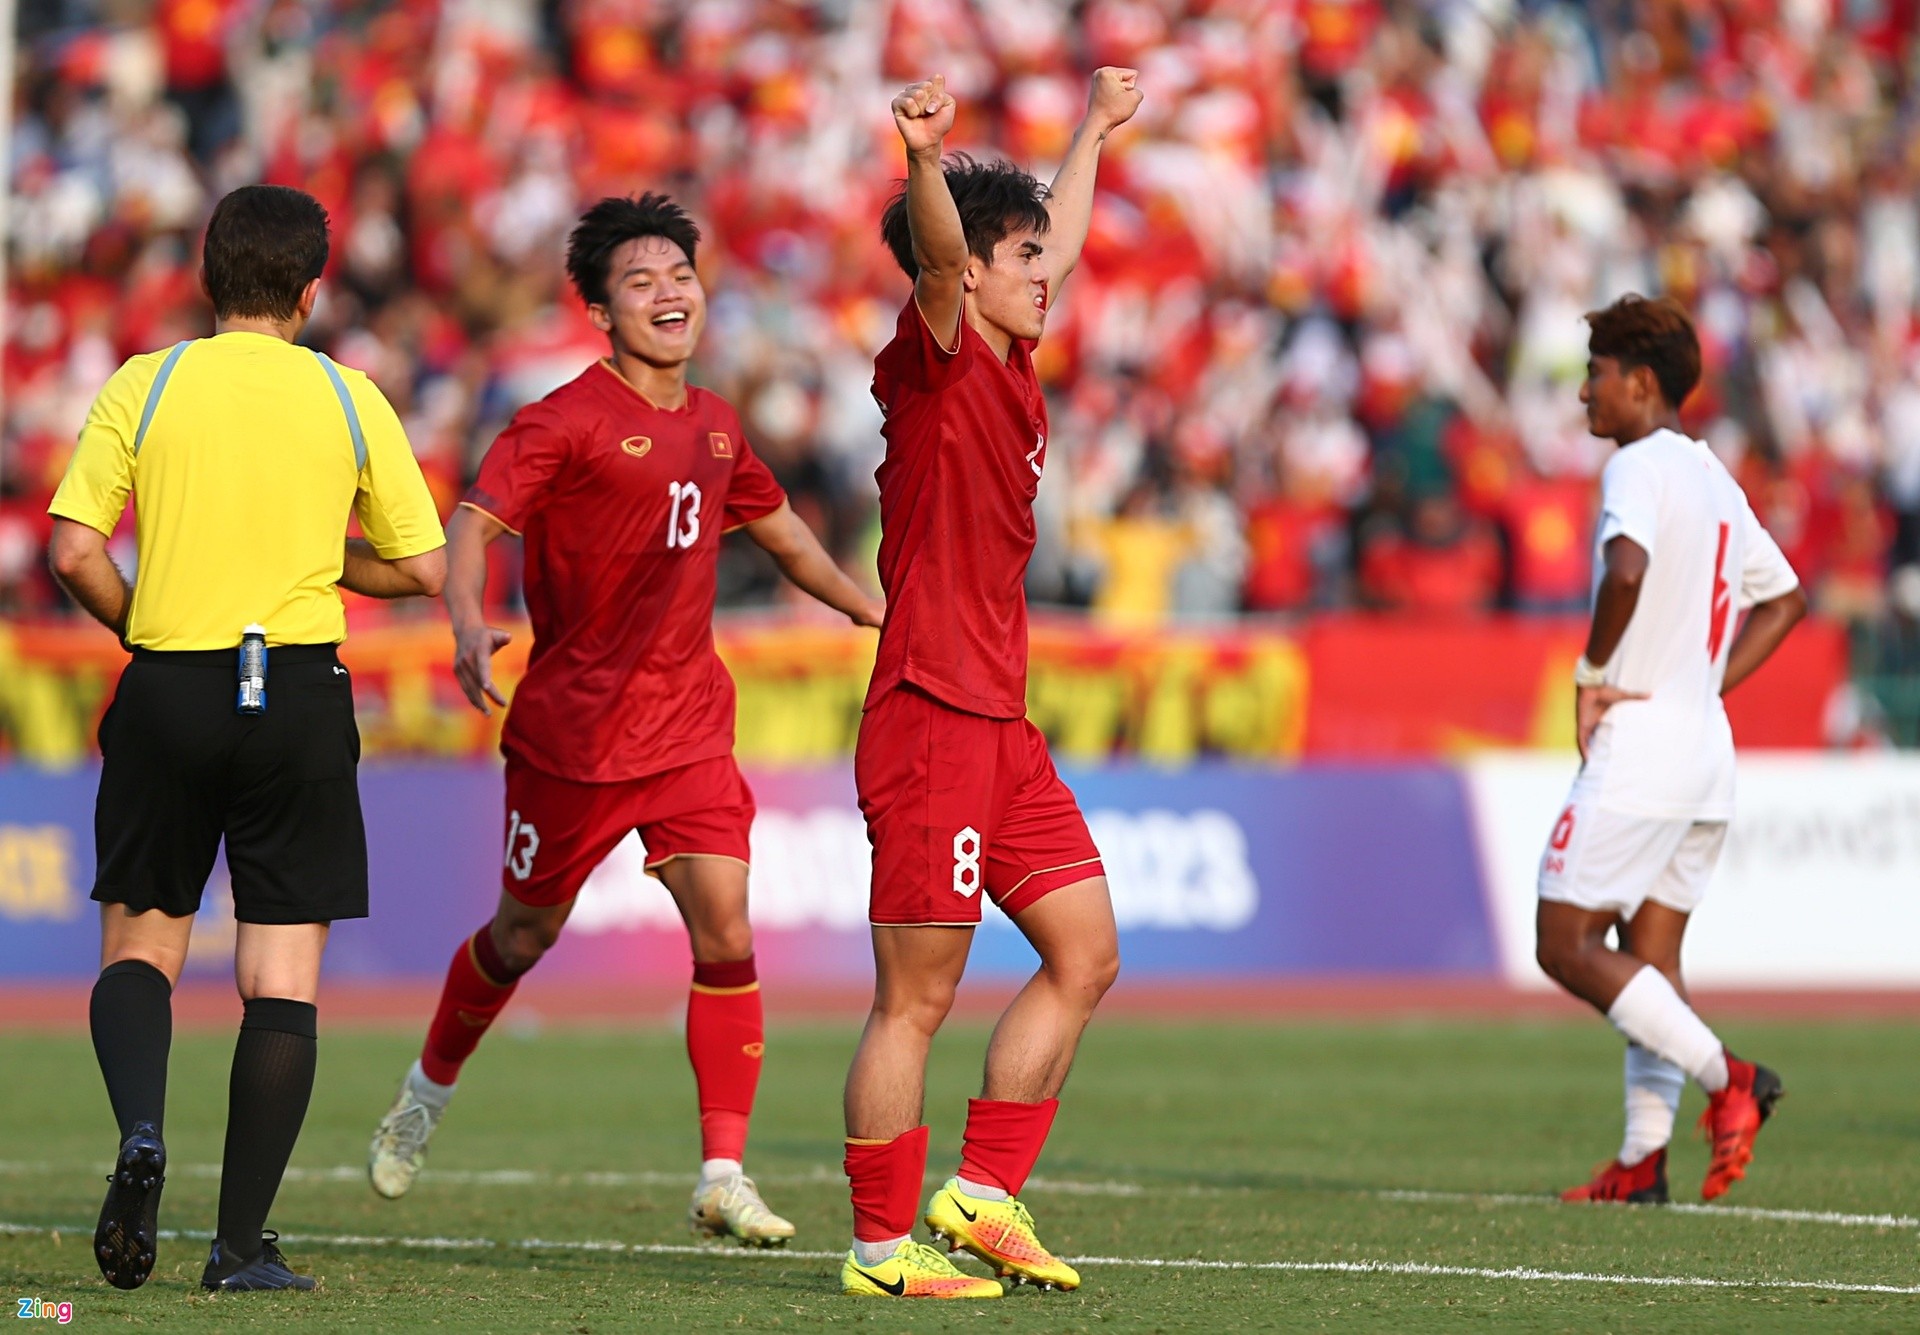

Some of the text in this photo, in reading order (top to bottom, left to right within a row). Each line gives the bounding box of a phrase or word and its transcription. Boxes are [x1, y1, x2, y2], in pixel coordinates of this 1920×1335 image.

[667, 480, 702, 549] 13
[505, 808, 541, 881] 13
[952, 825, 982, 899] 8
